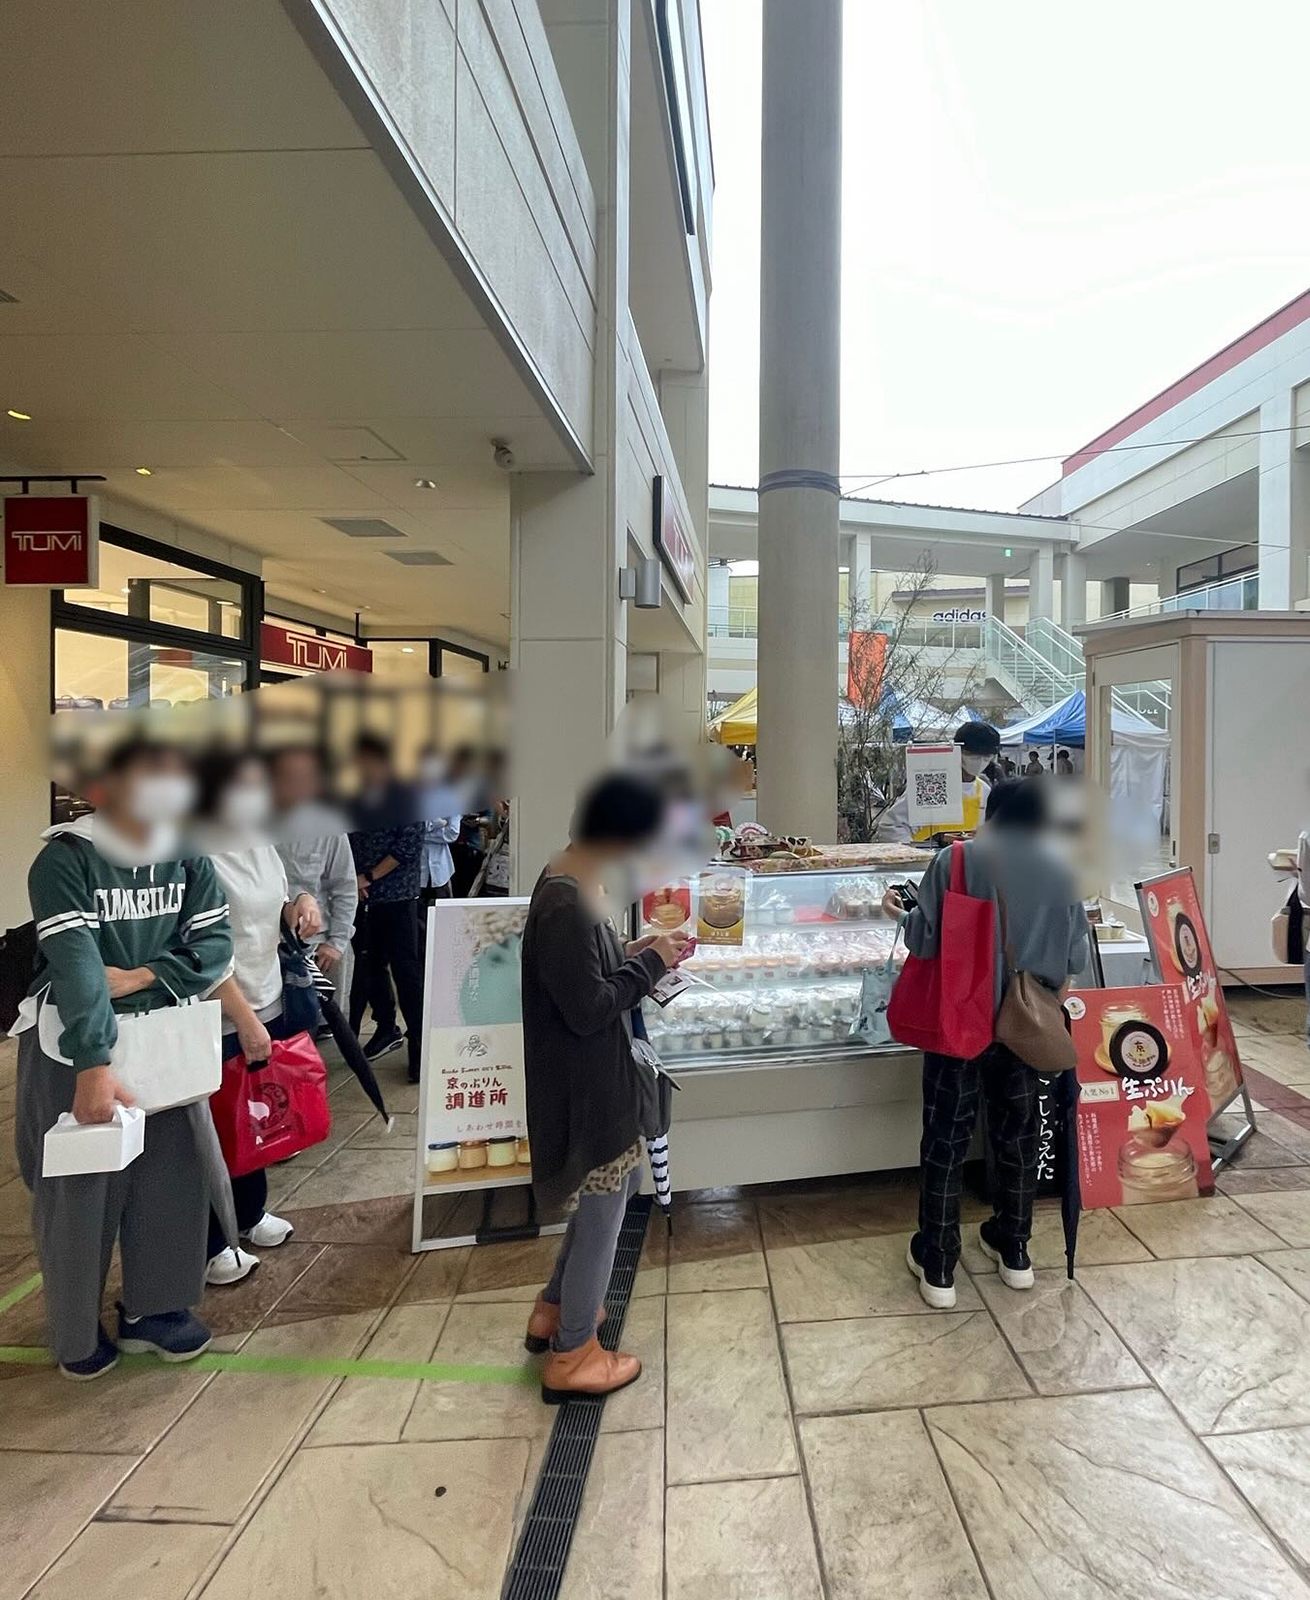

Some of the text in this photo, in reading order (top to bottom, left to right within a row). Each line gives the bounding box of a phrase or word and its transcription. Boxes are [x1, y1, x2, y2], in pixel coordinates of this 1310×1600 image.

[11, 530, 82, 551] TUMI
[286, 632, 347, 670] TUMI
[445, 1088, 509, 1111] 調進所
[1122, 1076, 1196, 1100] 生ぷりん
